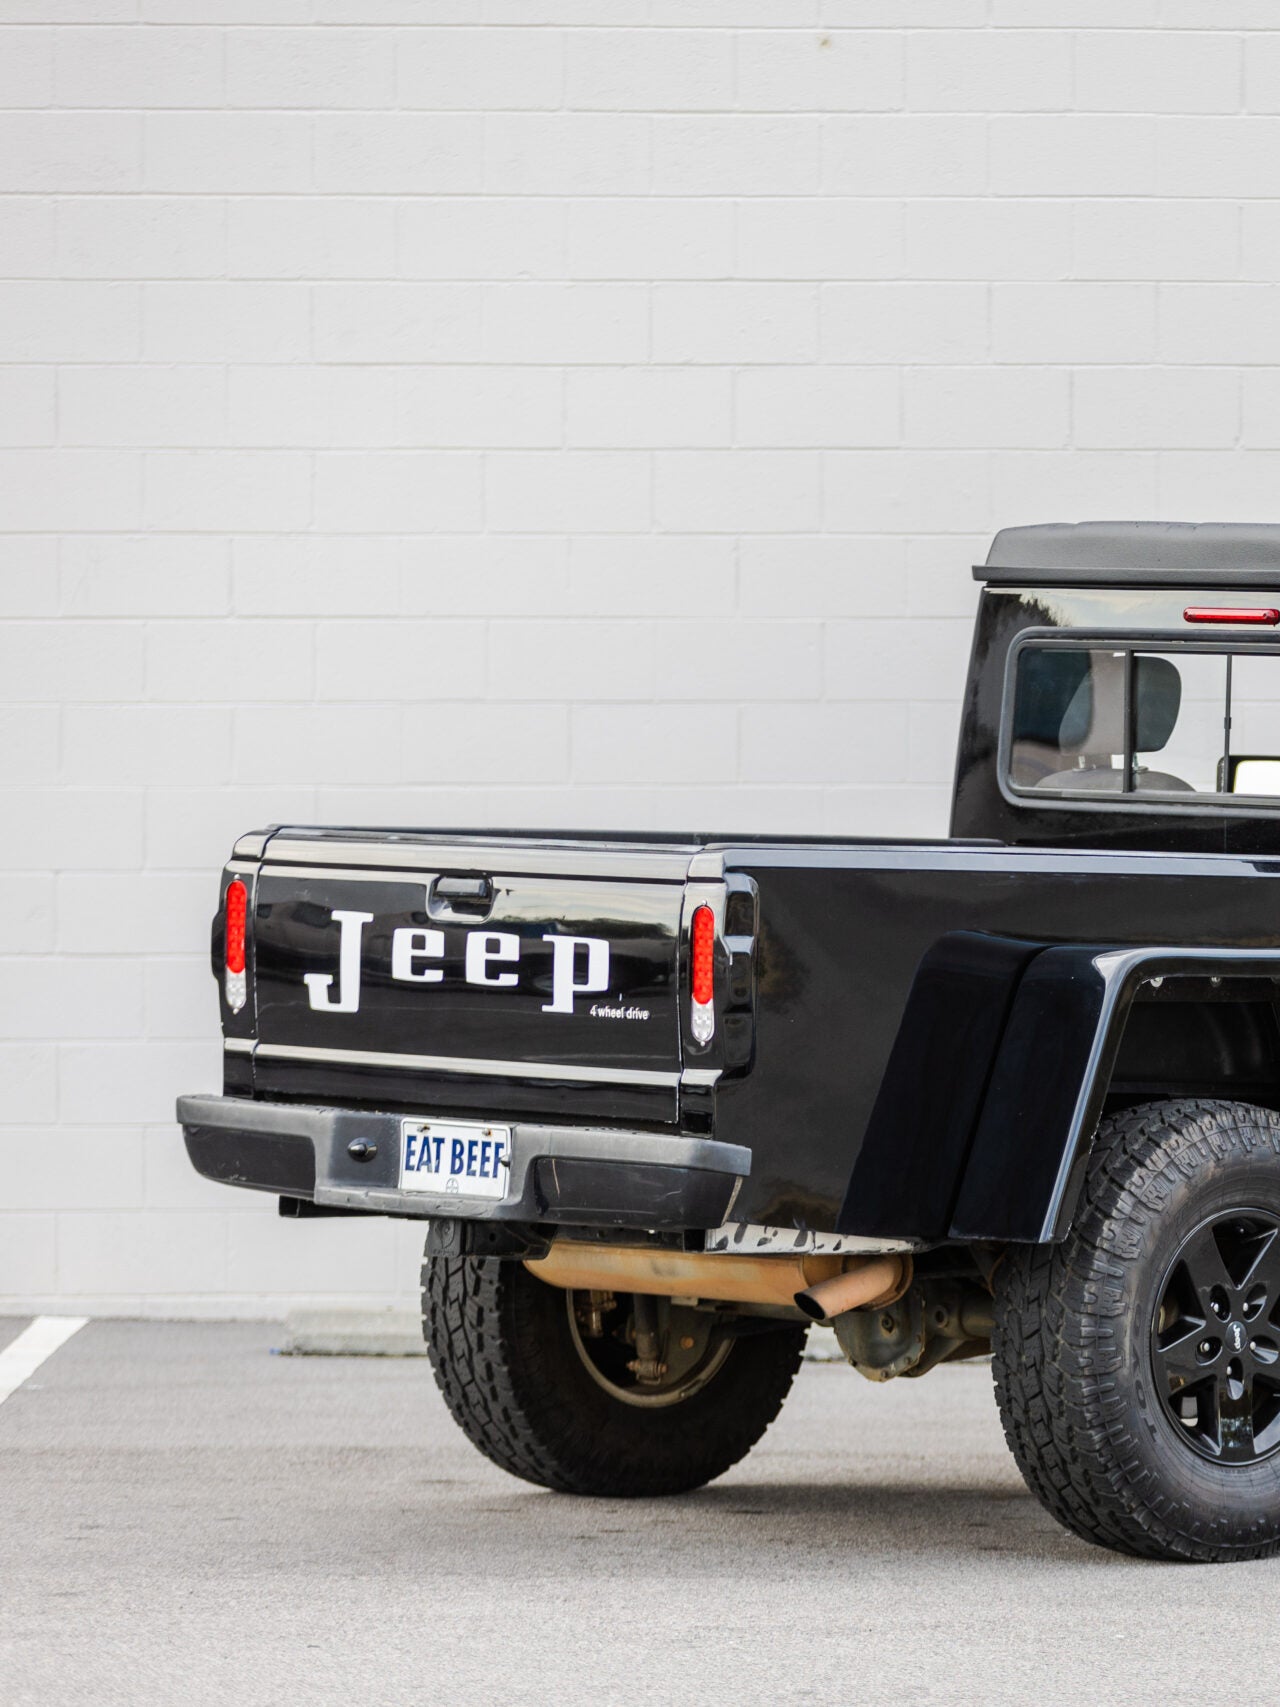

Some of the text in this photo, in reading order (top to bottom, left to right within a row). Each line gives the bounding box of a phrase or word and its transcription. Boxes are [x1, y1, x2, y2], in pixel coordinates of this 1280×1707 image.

[304, 909, 609, 1014] Jeep
[590, 1004, 650, 1020] 4 wheel drive
[405, 1135, 504, 1179] EAT BEEF
[1132, 1303, 1157, 1442] TOYO
